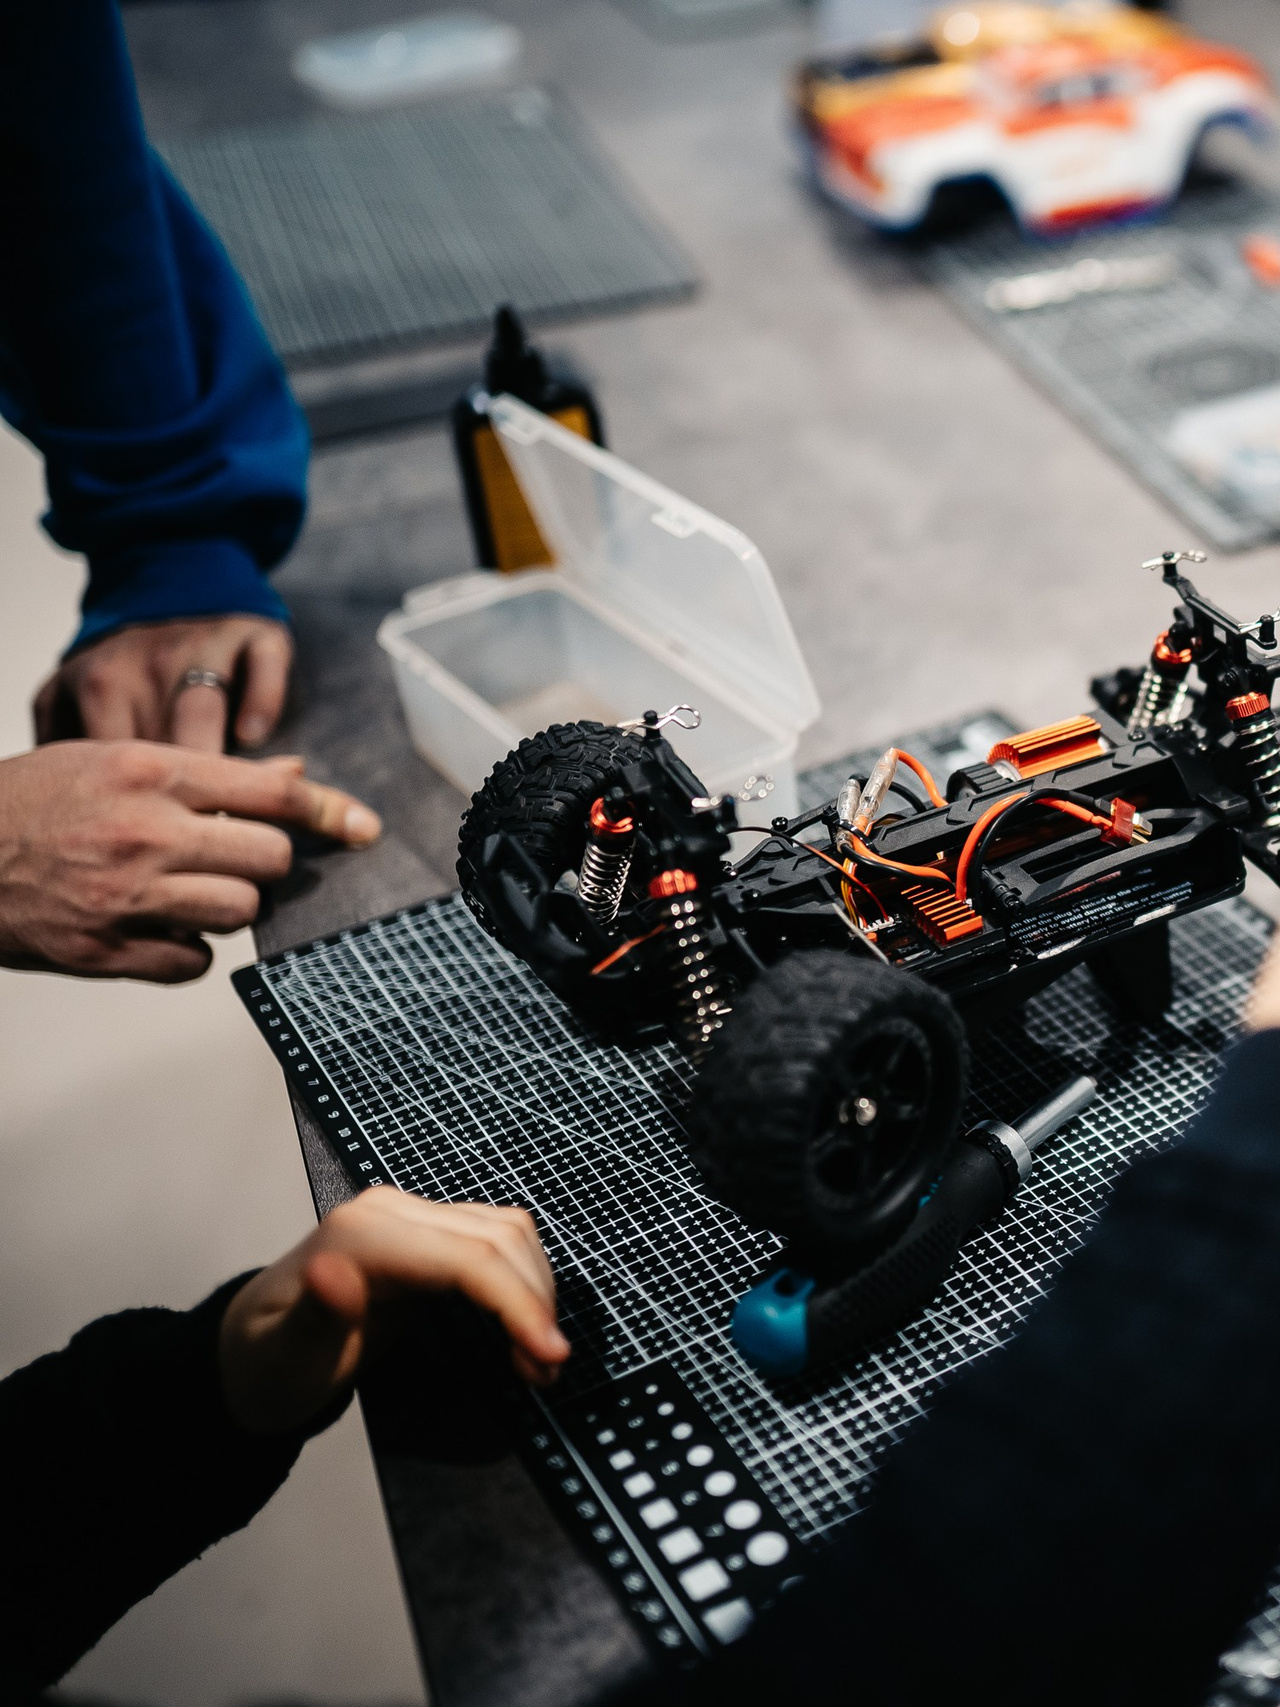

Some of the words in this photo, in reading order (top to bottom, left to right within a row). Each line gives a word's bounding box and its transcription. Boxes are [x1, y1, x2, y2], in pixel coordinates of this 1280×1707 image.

[1053, 911, 1073, 921] plug
[1080, 897, 1107, 910] linked
[1106, 893, 1117, 901] to
[1117, 889, 1132, 898] the
[1099, 909, 1114, 918] not
[1124, 900, 1140, 909] use
[1019, 926, 1048, 941] roperly
[1060, 913, 1084, 925] avoid
[287, 1046, 300, 1057] 5
[297, 1063, 310, 1072] 6
[317, 1094, 330, 1104] 8
[327, 1110, 340, 1119] 9
[346, 1141, 361, 1152] 11
[359, 1160, 374, 1172] 12
[368, 1176, 383, 1187] 13
